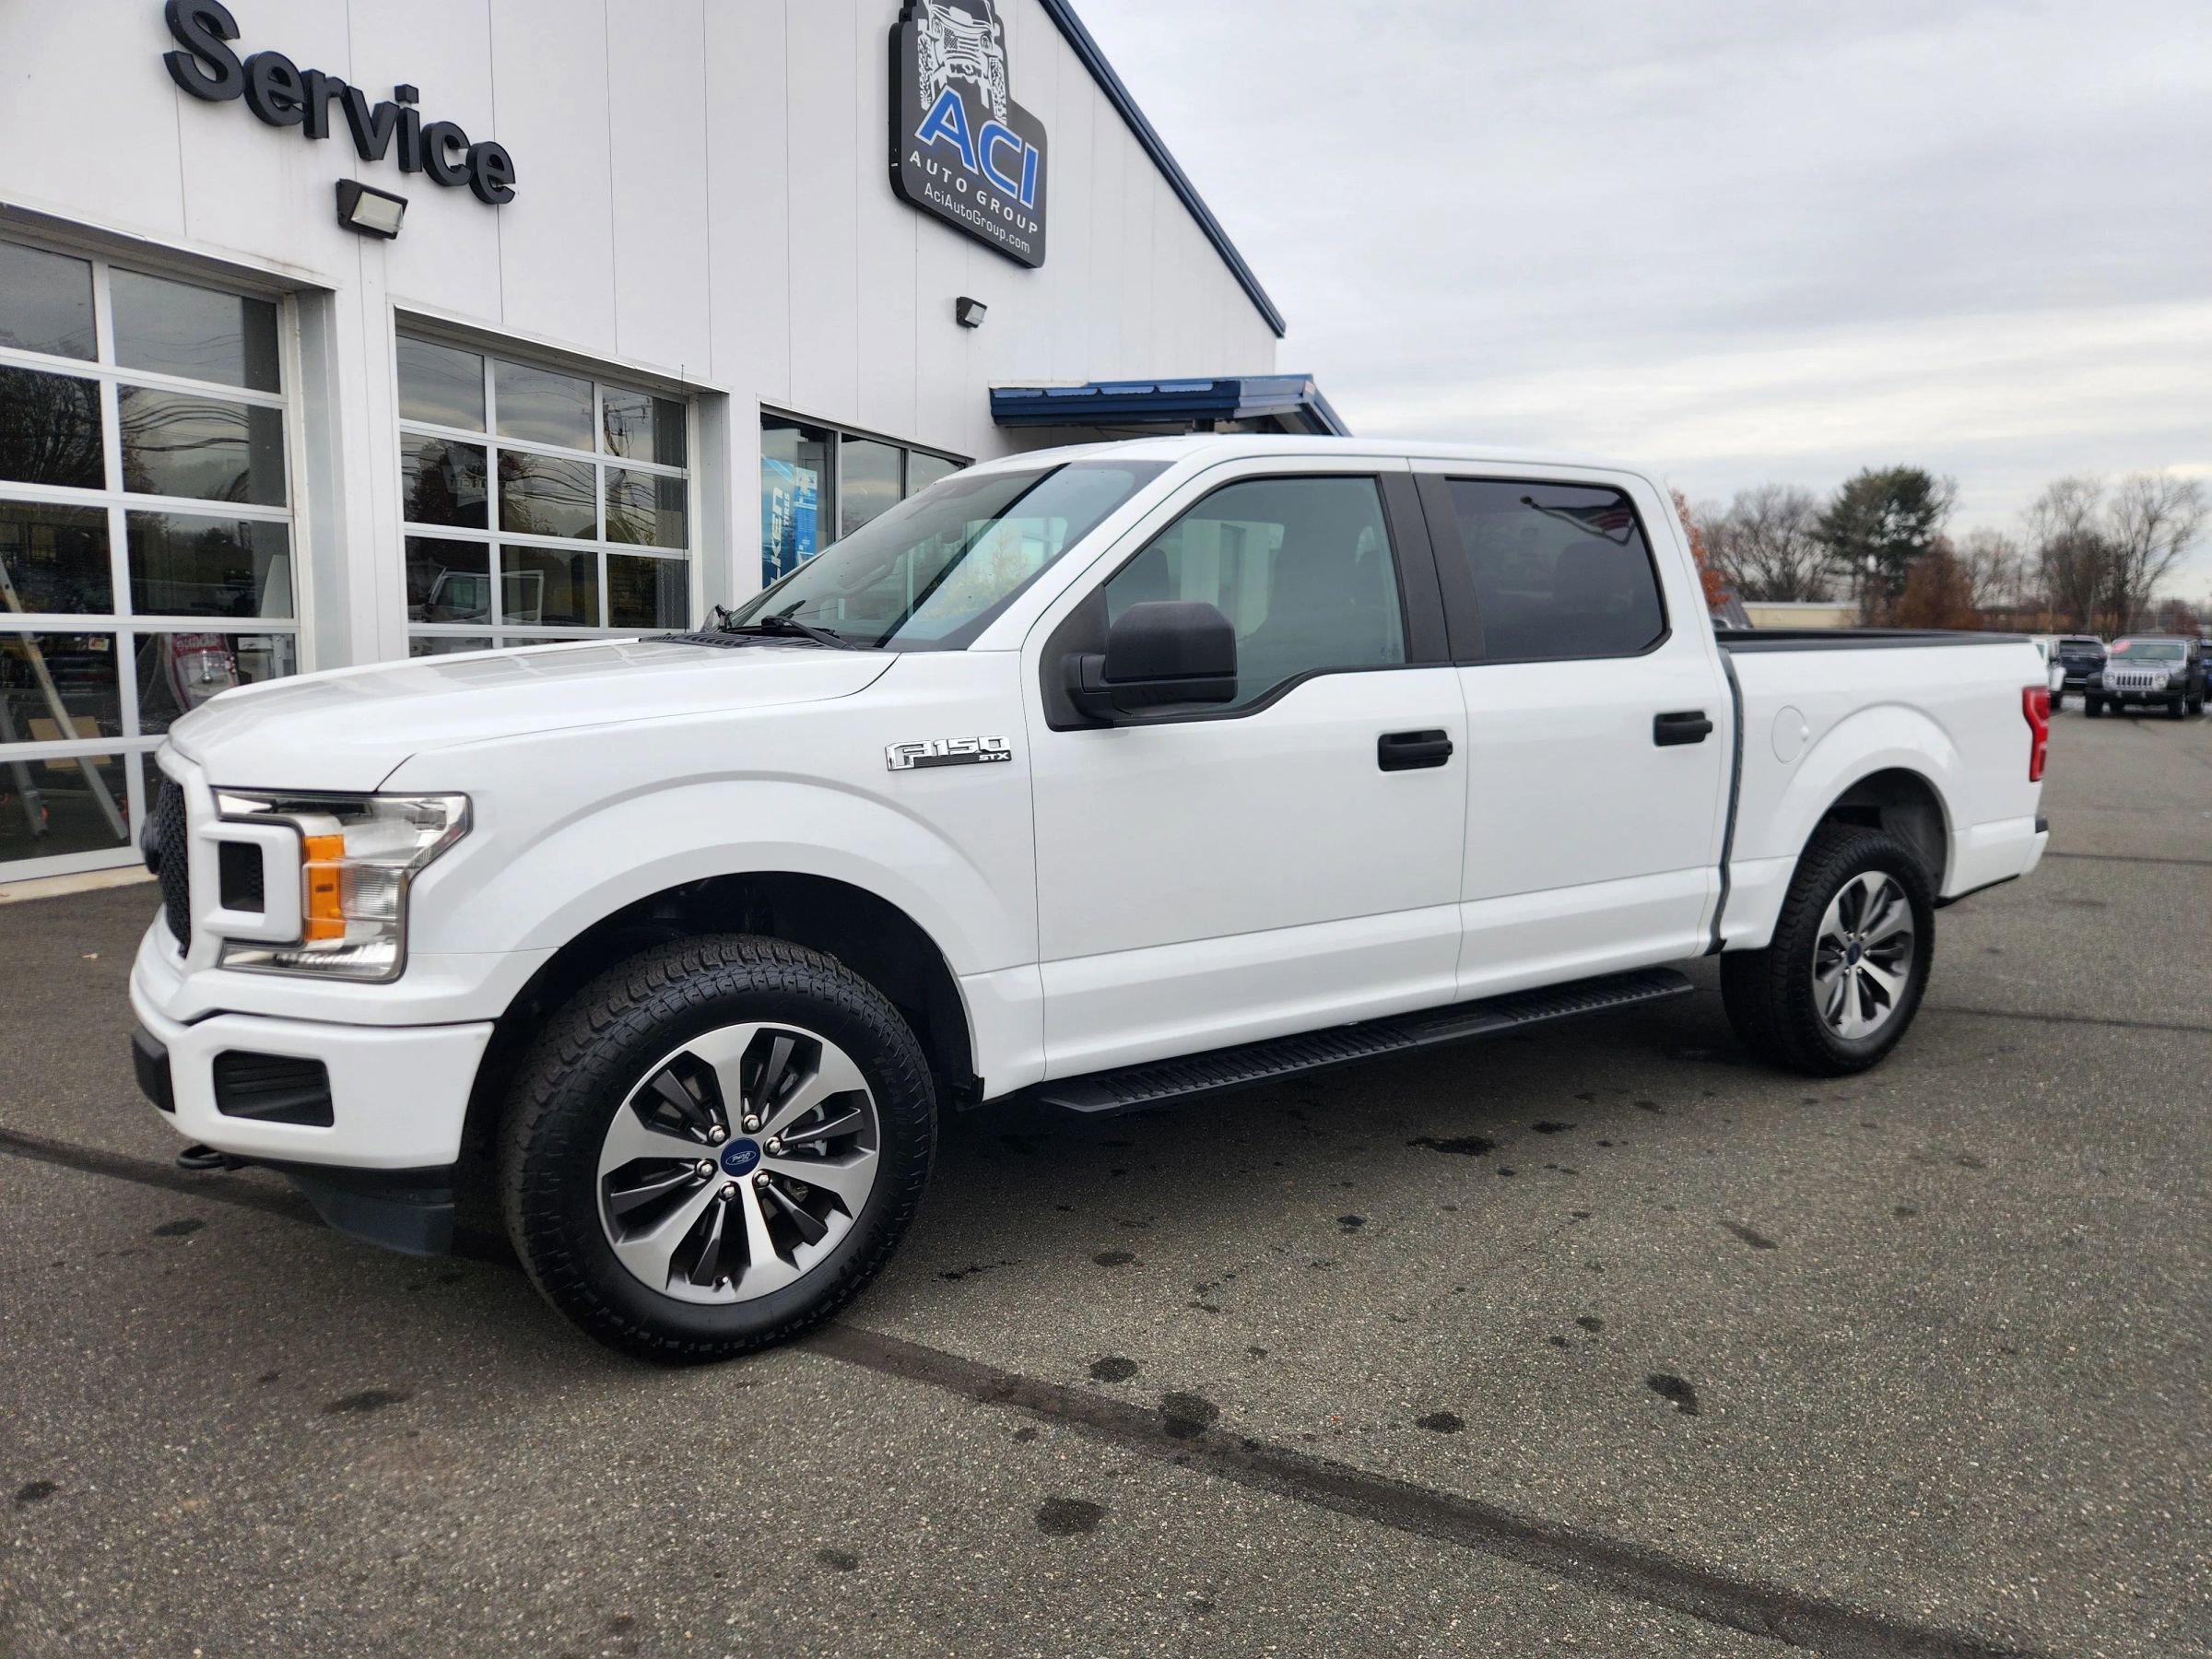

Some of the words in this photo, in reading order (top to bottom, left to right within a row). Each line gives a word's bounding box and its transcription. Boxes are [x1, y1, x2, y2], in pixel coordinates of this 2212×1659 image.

[163, 0, 516, 205] Service
[914, 84, 1040, 210] ACI
[909, 150, 968, 193] AUTO
[976, 192, 1038, 234] GROUP
[924, 182, 1030, 253] AciAutoGroup.com
[979, 752, 1010, 761] STX
